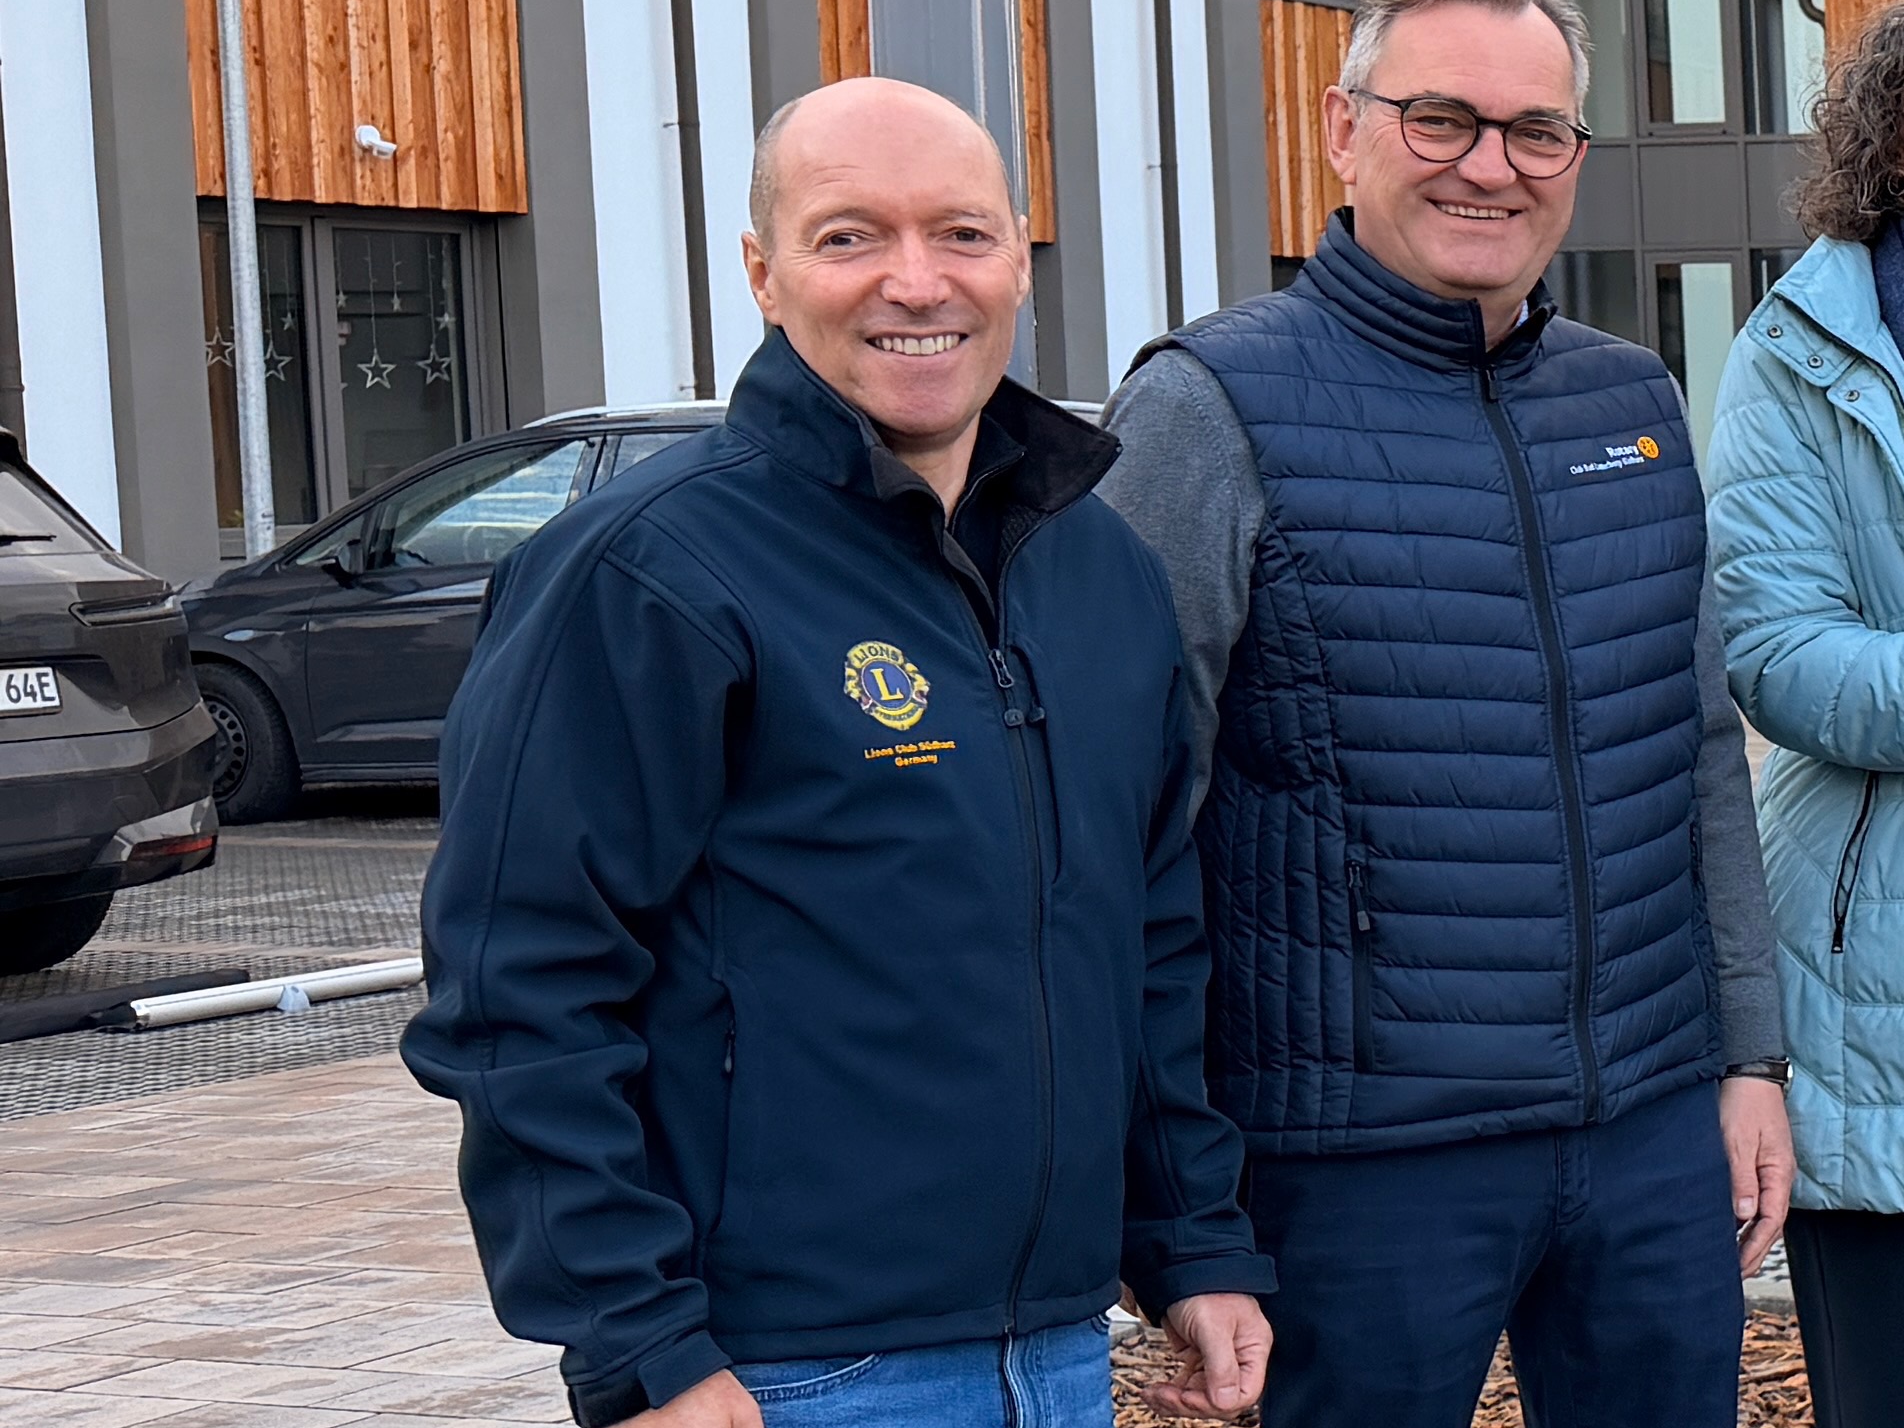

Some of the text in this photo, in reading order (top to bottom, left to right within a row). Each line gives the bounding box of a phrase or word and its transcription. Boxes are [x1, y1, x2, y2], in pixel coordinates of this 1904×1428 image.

[853, 645, 898, 663] LIONS
[5, 672, 56, 704] 64E
[870, 668, 904, 701] L
